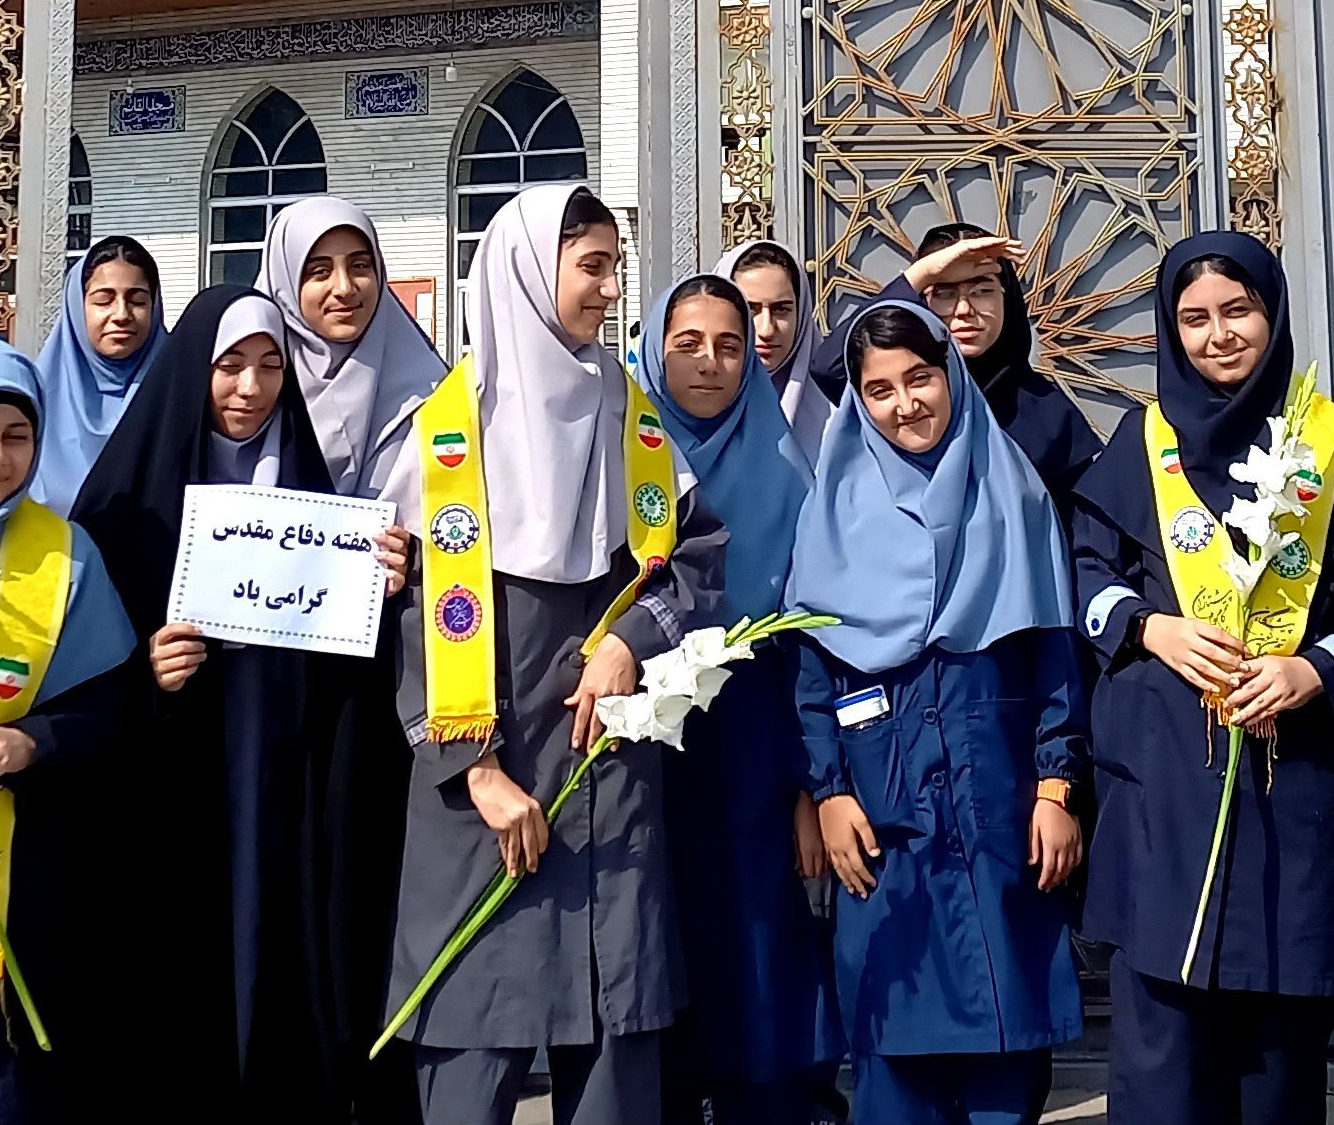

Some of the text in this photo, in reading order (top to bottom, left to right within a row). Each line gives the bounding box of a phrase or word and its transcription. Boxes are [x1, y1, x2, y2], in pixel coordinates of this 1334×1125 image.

[212, 519, 373, 553] هفته دفاع مقدس
[232, 578, 329, 614] گرامی باد
